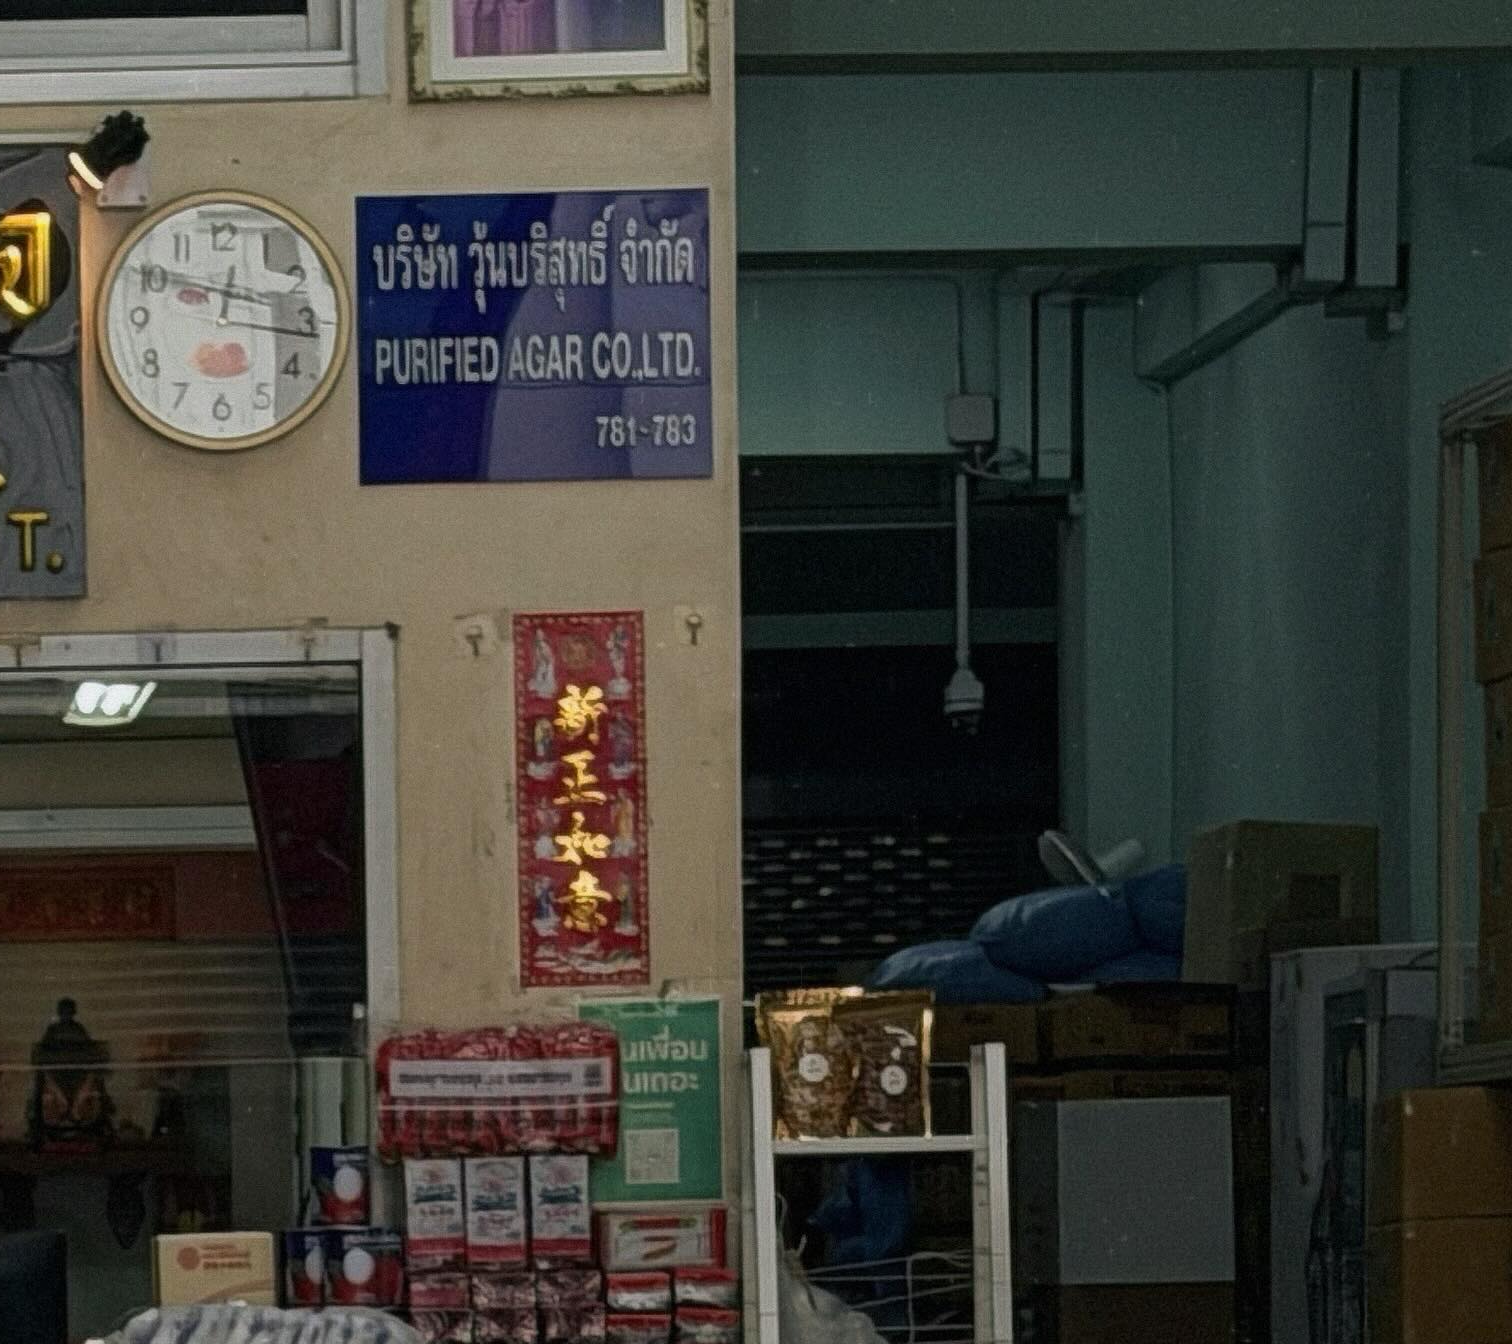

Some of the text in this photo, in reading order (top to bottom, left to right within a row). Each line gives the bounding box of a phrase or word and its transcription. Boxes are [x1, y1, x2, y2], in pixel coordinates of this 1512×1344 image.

[173, 233, 191, 263] 11
[211, 221, 237, 252] 12
[372, 204, 696, 315] บริษัท วุ้นบริสุทธิ์ จำกัด
[140, 263, 168, 294] 10
[287, 265, 307, 296] 2
[129, 306, 150, 333] 9
[296, 306, 316, 337] 3
[142, 348, 160, 379] 8
[280, 351, 301, 379] 4
[374, 331, 702, 386] PURIFIED AGAR CO.,LTD.
[171, 382, 189, 410] 7
[212, 393, 232, 422] 6
[253, 382, 272, 411] 5
[595, 414, 697, 448] 781-783
